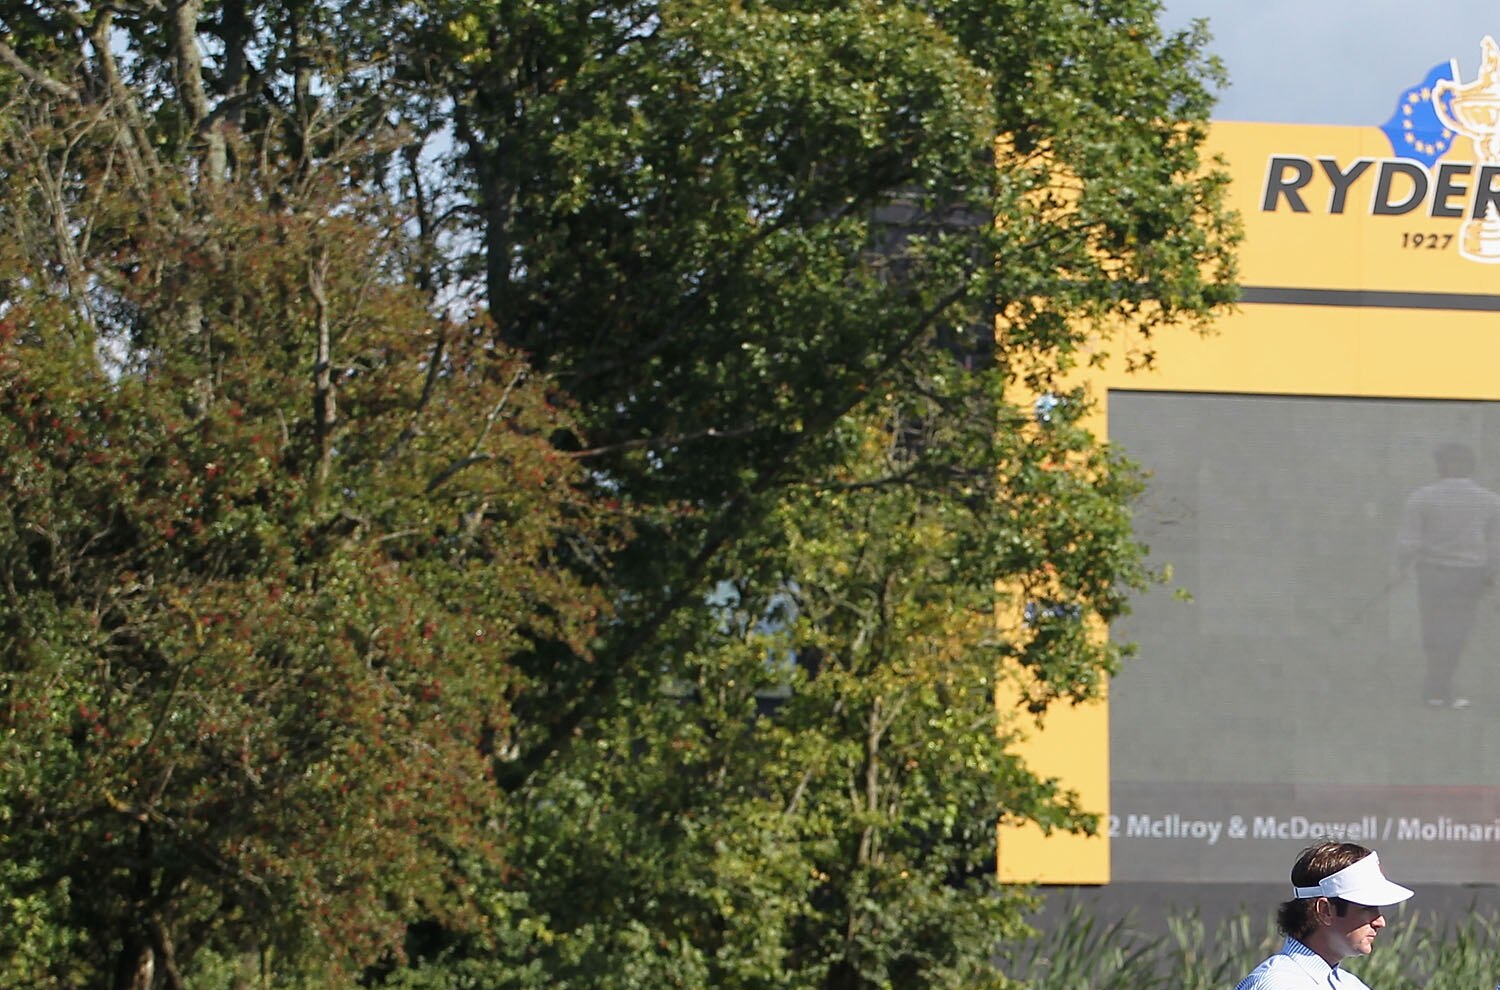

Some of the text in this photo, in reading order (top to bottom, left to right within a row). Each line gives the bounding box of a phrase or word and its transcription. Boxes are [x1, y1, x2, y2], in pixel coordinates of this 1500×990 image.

[1401, 232, 1454, 251] 1927
[1126, 813, 1223, 845] McIlroy
[1228, 815, 1248, 839] &
[1253, 815, 1377, 841] McDowell
[1382, 817, 1393, 841] /
[1397, 816, 1500, 842] Molinari
